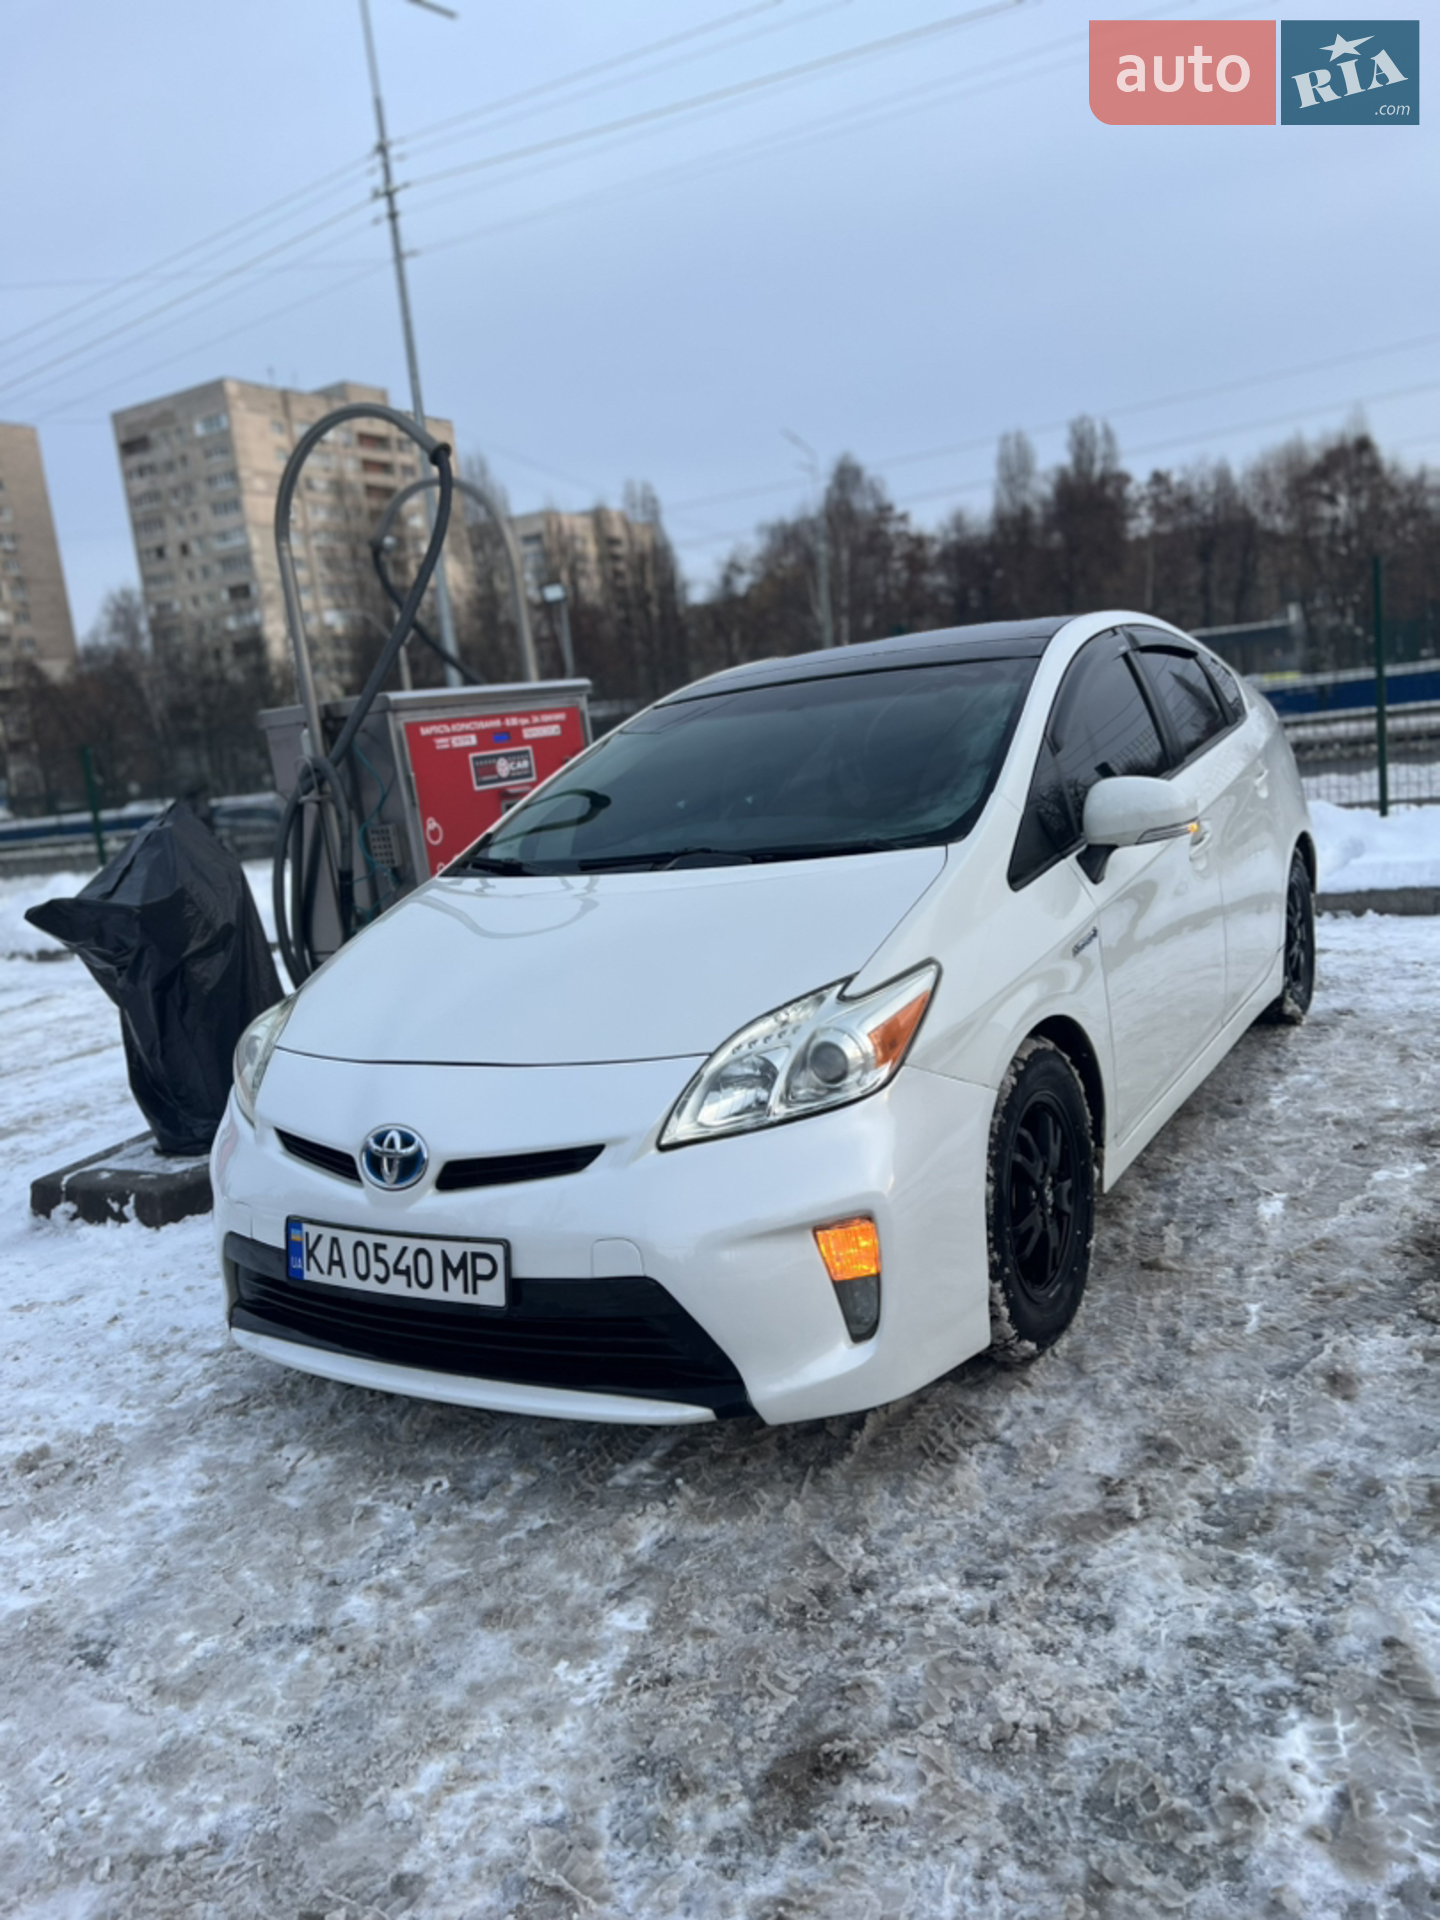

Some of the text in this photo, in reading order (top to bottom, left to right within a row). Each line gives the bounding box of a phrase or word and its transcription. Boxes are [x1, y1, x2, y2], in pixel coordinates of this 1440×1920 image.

[290, 1255, 303, 1269] UA
[305, 1232, 498, 1295] KA 0540 MP
